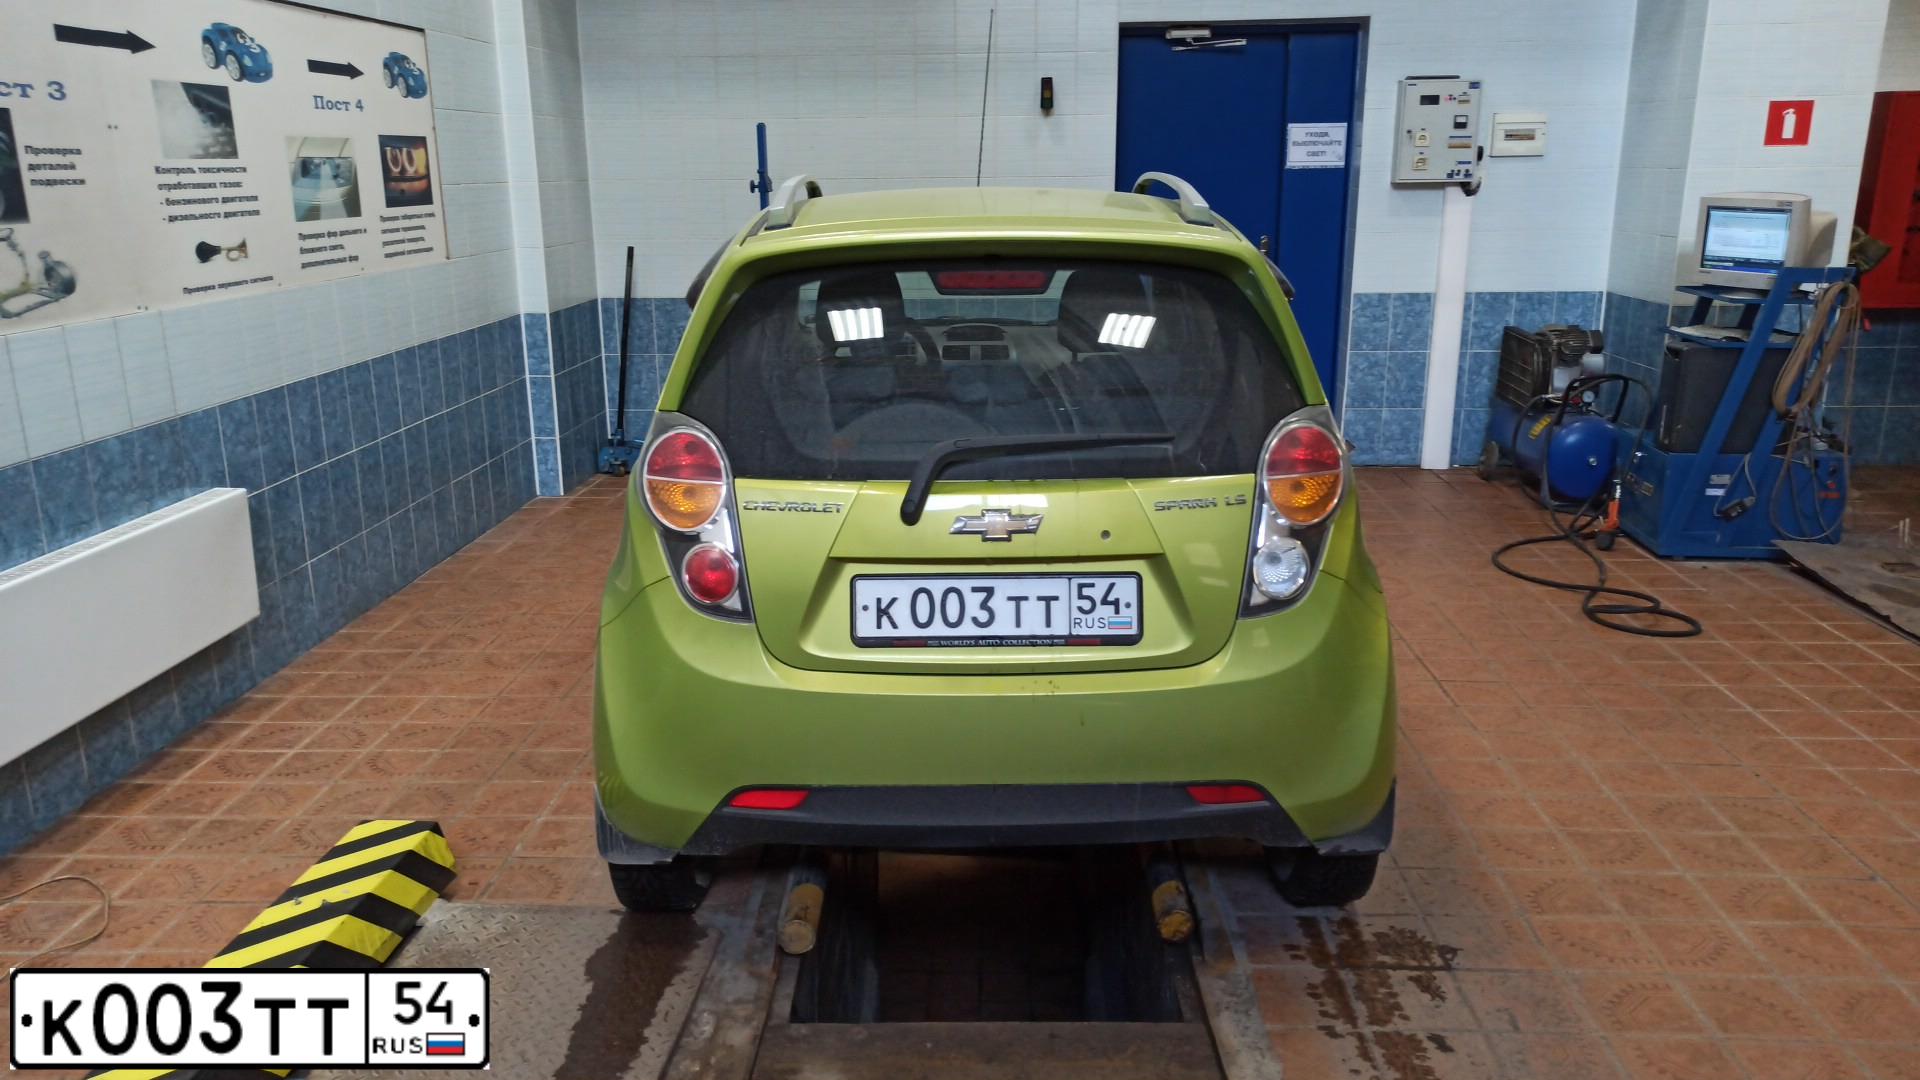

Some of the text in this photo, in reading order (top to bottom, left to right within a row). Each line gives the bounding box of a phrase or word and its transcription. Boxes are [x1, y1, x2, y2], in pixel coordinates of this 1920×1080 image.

[47, 80, 67, 101] 3
[312, 95, 364, 112] Пост 4
[24, 145, 82, 157] Проверка
[27, 161, 76, 172] деталей
[154, 165, 247, 176] Контроль токсичности
[30, 178, 86, 188] подвески
[165, 197, 219, 206] бензинового
[221, 195, 258, 204] двигателя
[168, 212, 221, 222] дизельного
[223, 209, 261, 219] двигателя
[742, 500, 845, 514] CHEVROLET
[1153, 494, 1247, 512] SPARK LS
[1076, 582, 1121, 615] 54
[1073, 617, 1107, 629] RUS
[939, 638, 1052, 647] WORLD'S AUTO COLLECTION
